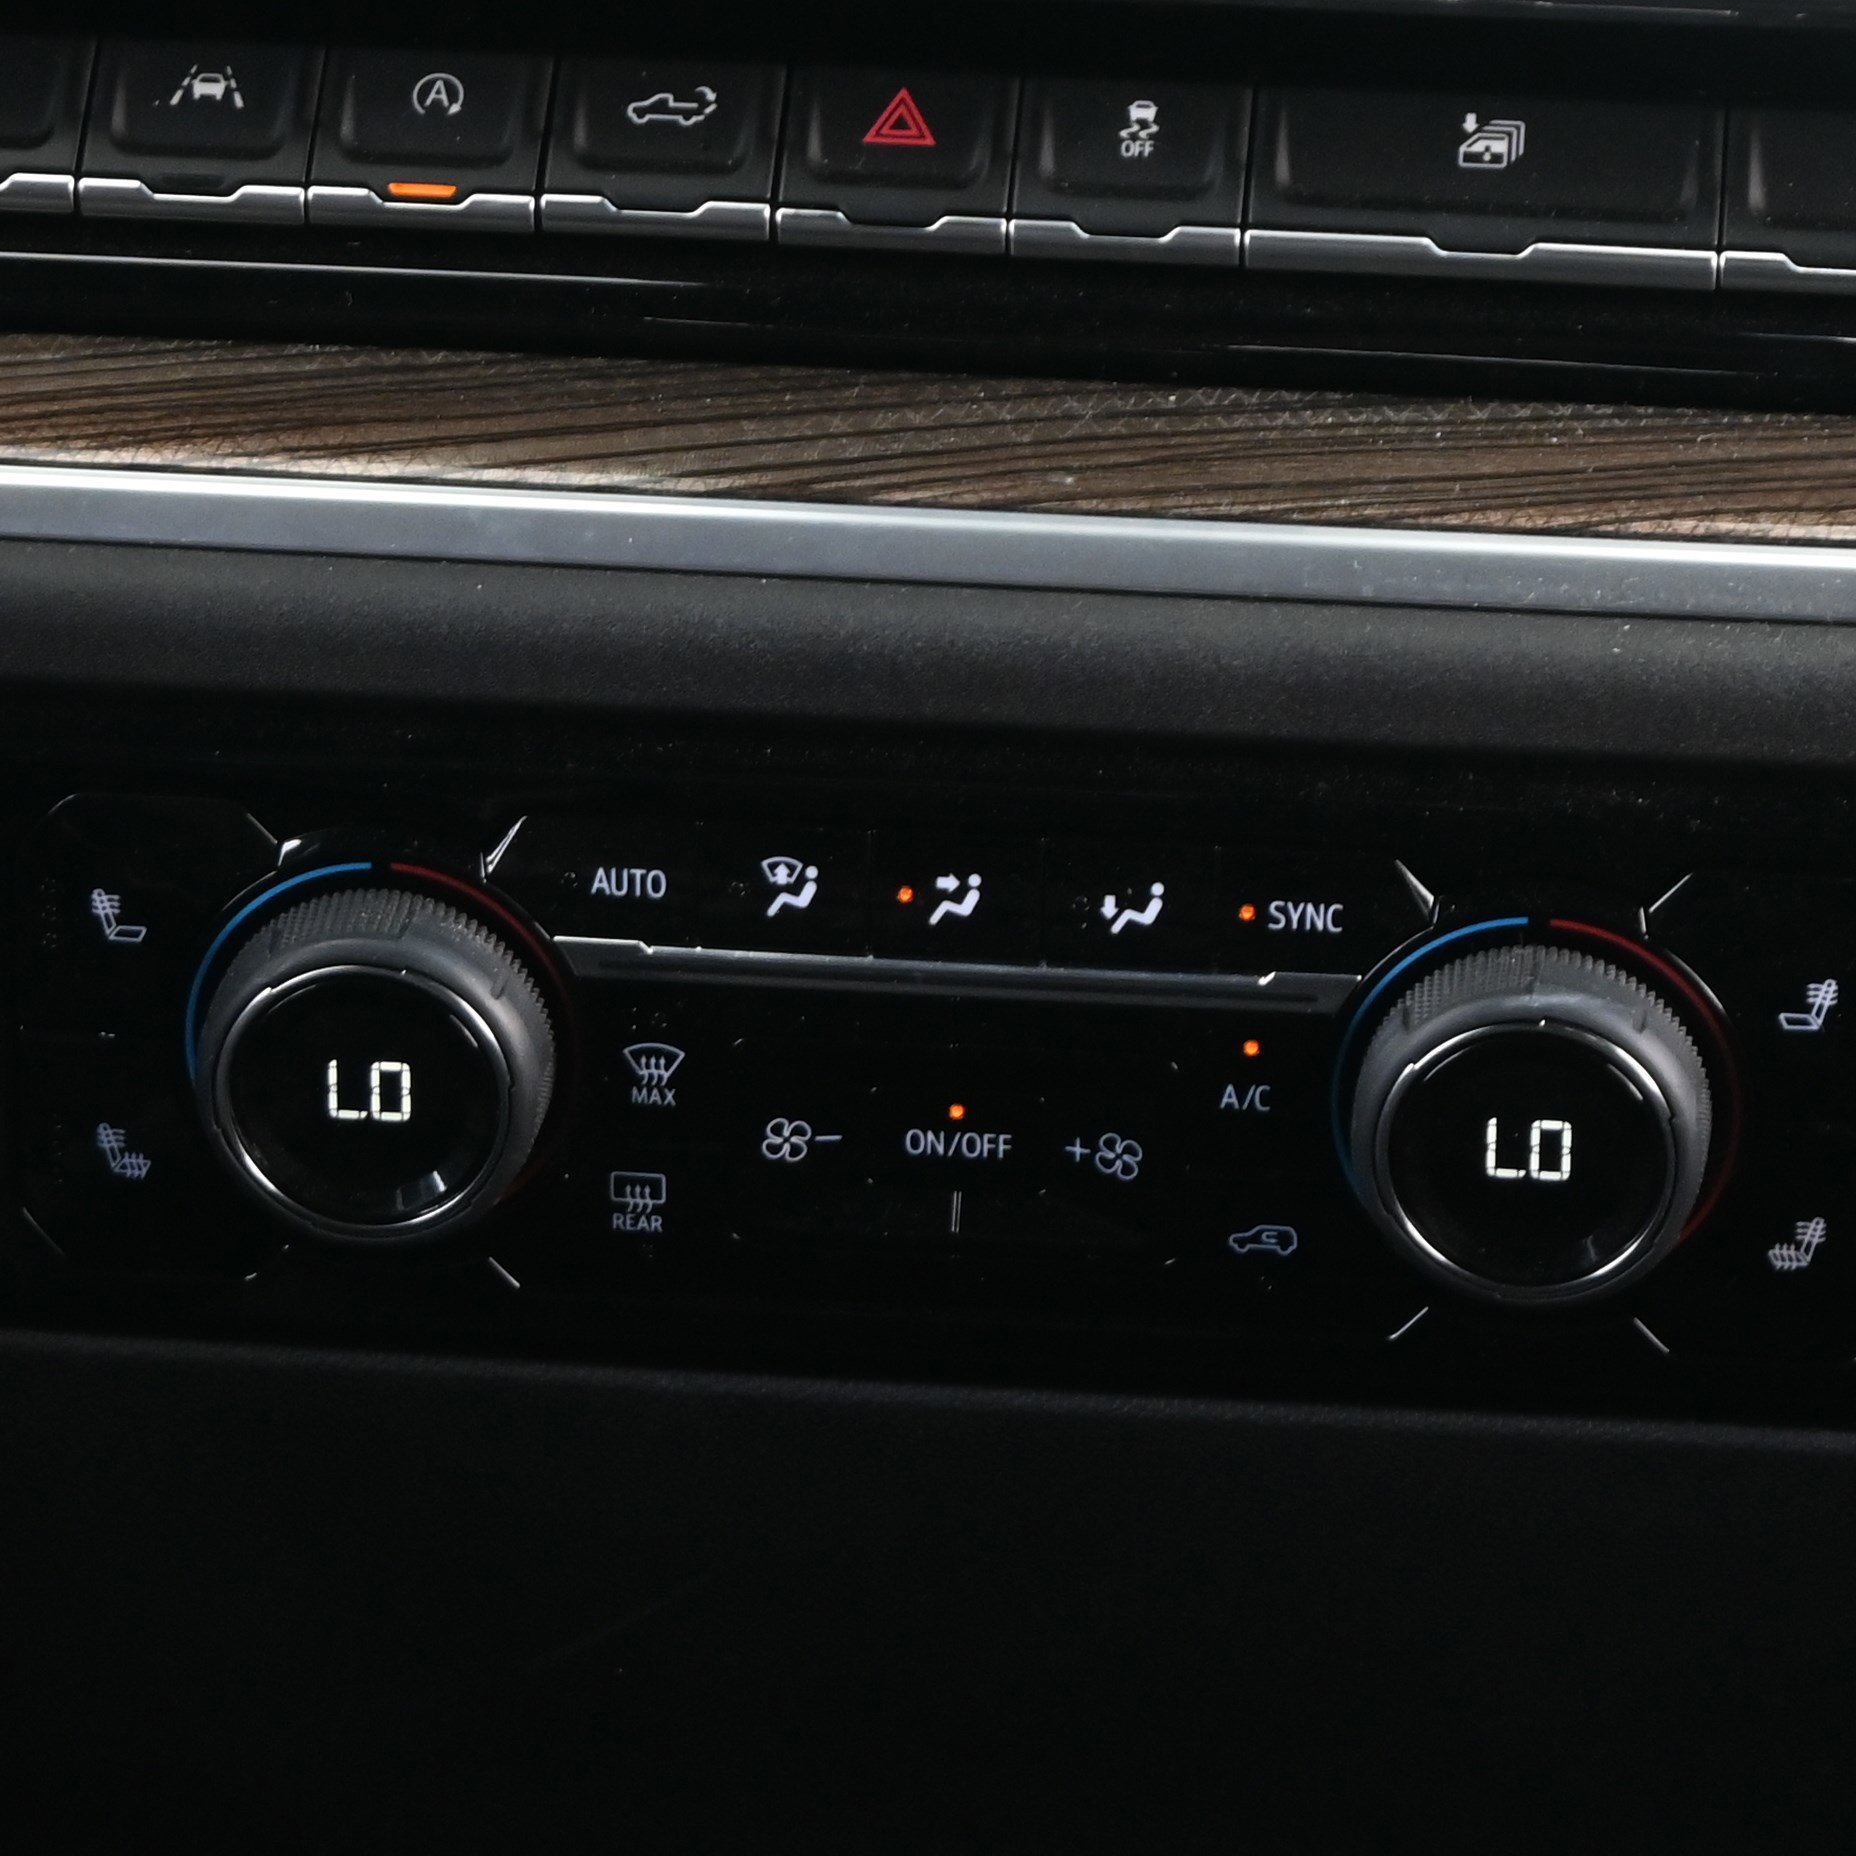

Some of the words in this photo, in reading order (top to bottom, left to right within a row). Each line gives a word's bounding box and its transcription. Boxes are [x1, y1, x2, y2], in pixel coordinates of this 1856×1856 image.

[1121, 140, 1154, 157] OFF
[590, 867, 667, 899] AUTO
[1268, 900, 1343, 934] SYNC
[631, 1085, 677, 1106] MAX
[1220, 1084, 1271, 1113] A/C
[905, 1128, 1012, 1160] ON/OFF
[612, 1210, 663, 1233] REAR
